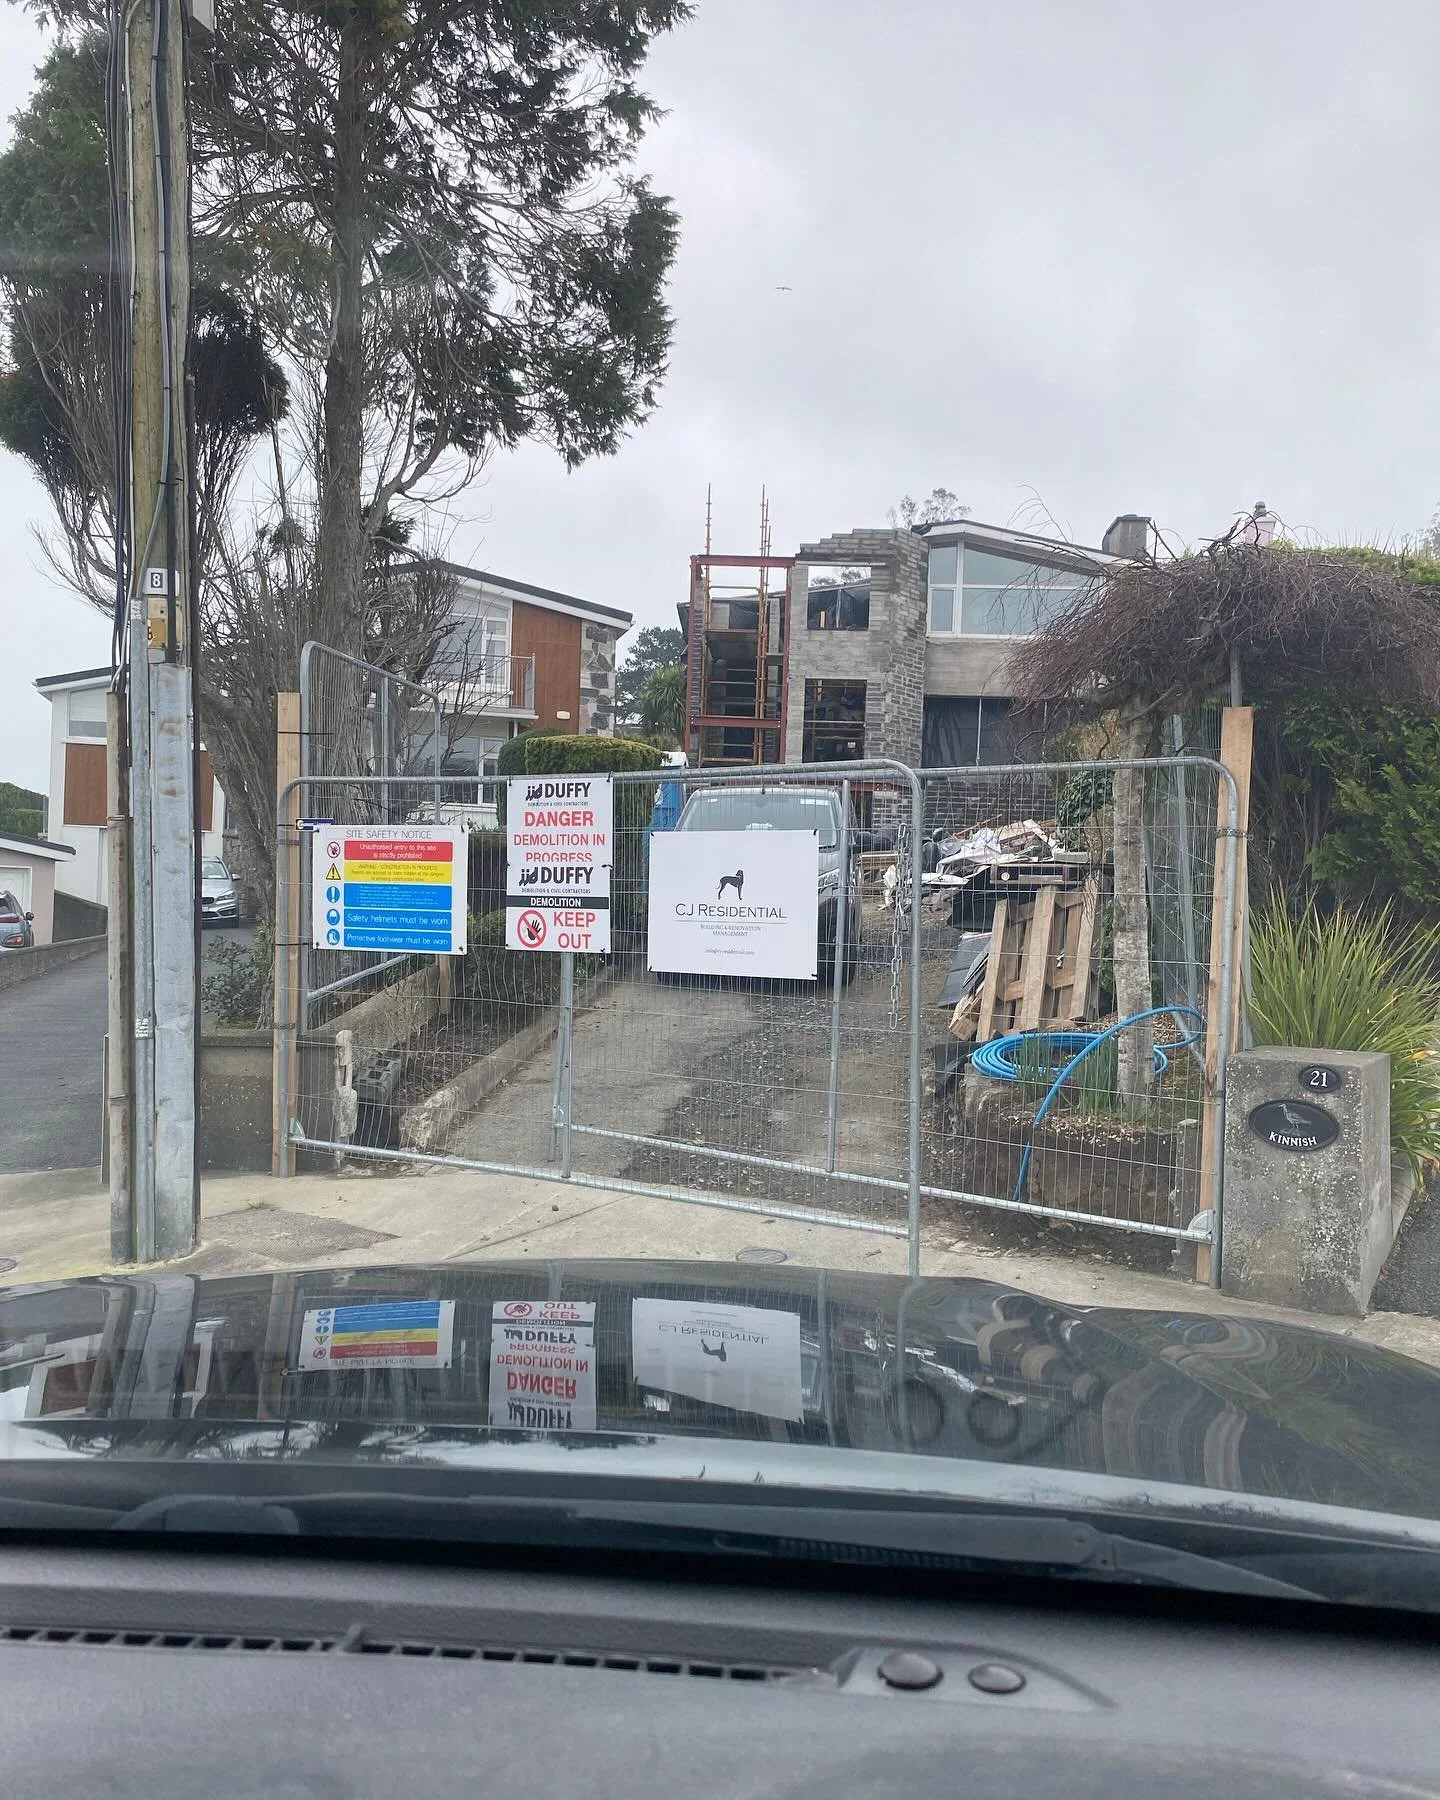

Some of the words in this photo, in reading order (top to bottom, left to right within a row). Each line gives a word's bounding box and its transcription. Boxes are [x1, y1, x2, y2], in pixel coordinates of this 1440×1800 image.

[152, 574, 160, 587] 8
[544, 782, 592, 798] DUFFY
[524, 811, 594, 827] DANGER
[346, 830, 363, 838] SITE
[367, 830, 398, 839] SAFETY
[402, 831, 432, 839] NOTICE
[514, 834, 588, 846] DEMOLITION
[593, 834, 605, 846] IN
[526, 852, 592, 862] PROGRESS
[541, 867, 594, 884] DUFFY
[530, 898, 581, 907] DEMOLITION
[675, 903, 694, 916] CJ
[698, 904, 787, 918] RESIDENTIAL
[347, 914, 369, 923] Safety
[371, 914, 397, 923] helmets
[400, 916, 417, 924] must
[420, 916, 428, 924] be
[554, 912, 596, 928] KEEP
[558, 933, 592, 949] OUT
[1310, 1070, 1328, 1087] 21
[1269, 1131, 1317, 1147] KINNISH
